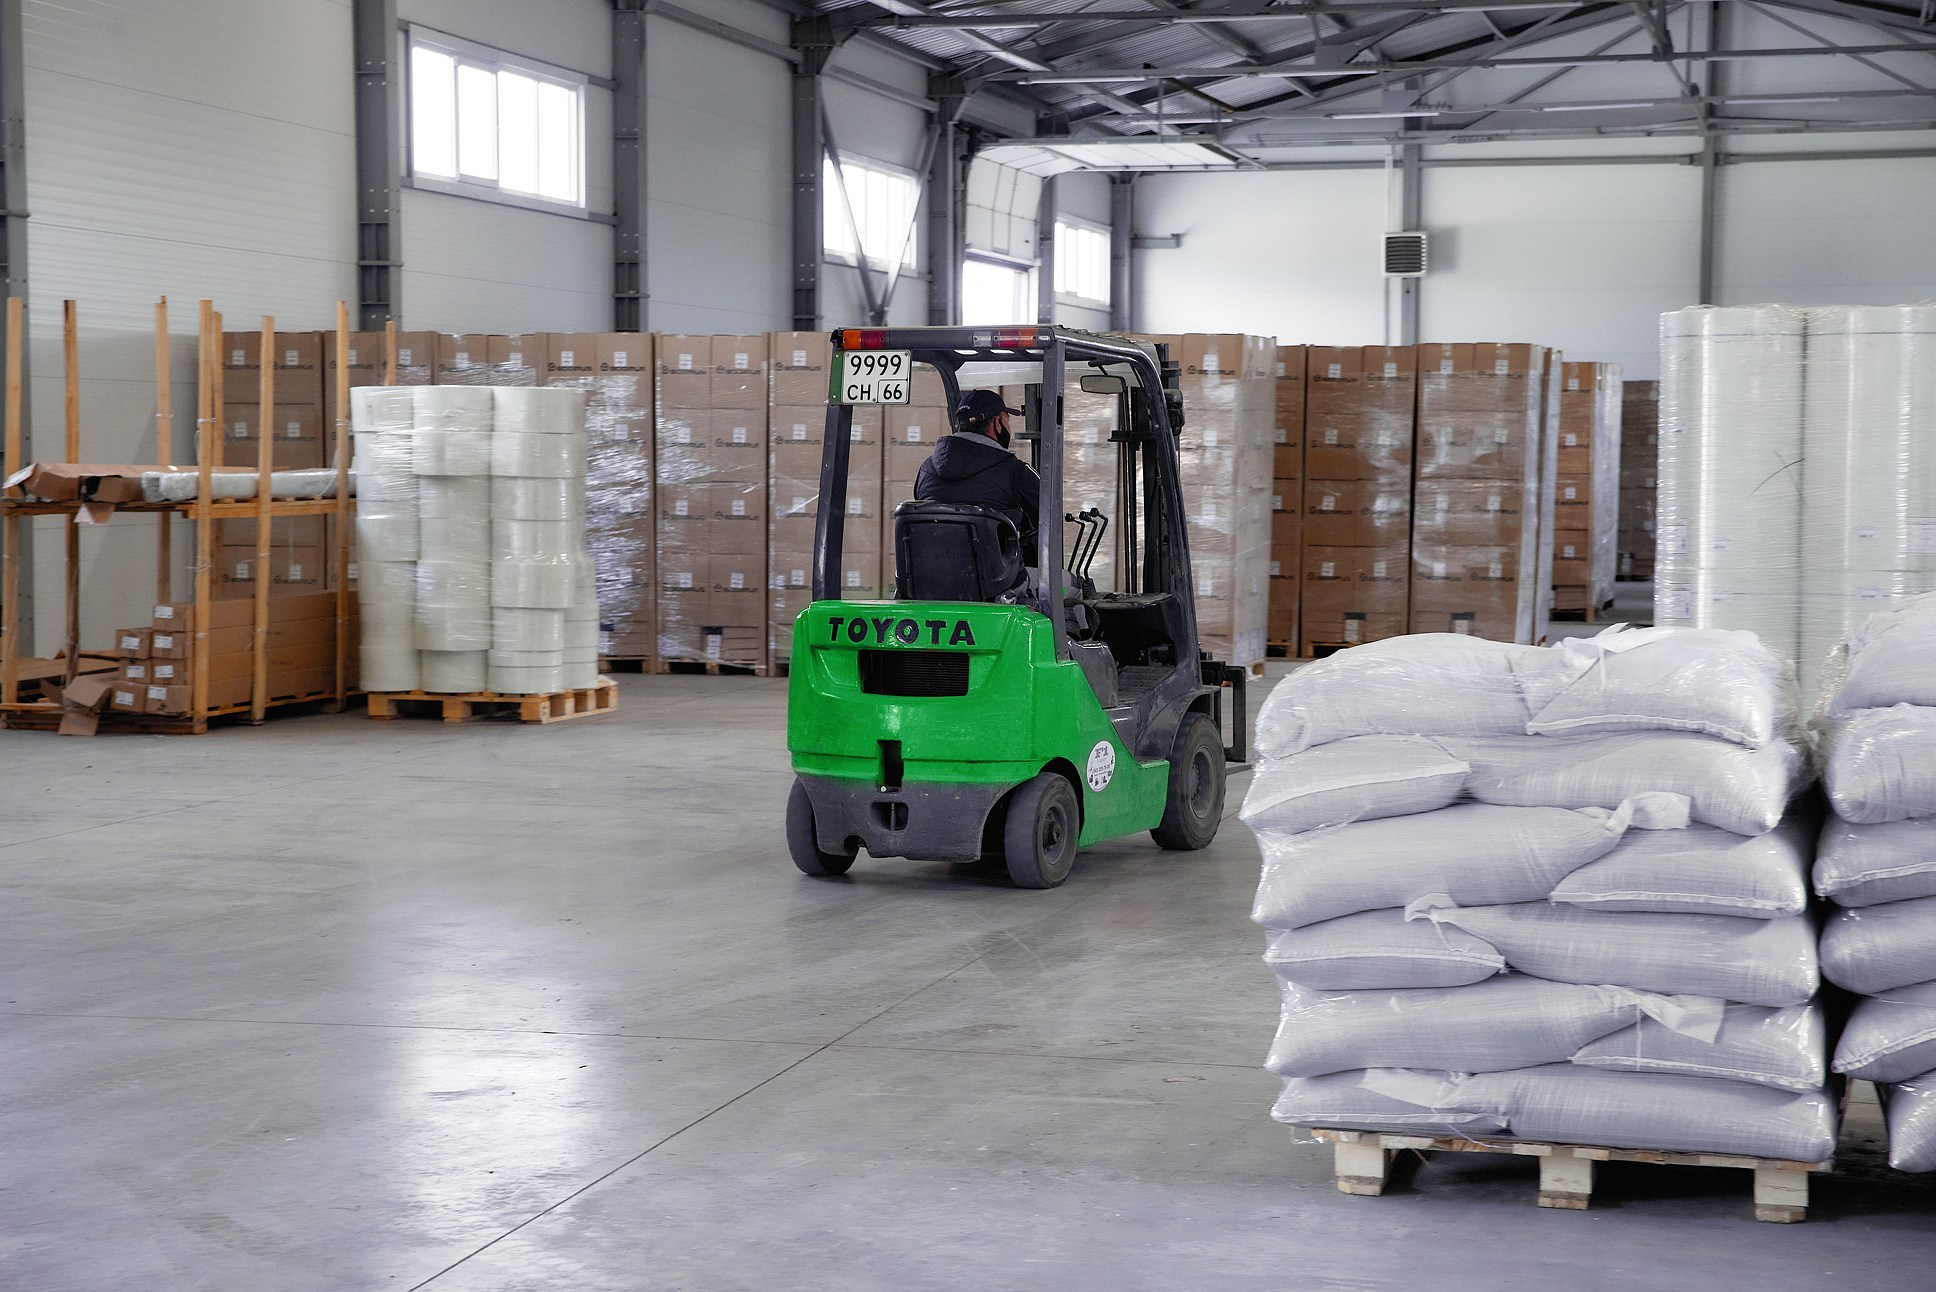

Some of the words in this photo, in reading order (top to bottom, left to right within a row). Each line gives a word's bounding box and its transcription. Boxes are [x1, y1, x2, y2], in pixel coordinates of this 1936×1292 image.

[850, 354, 902, 376] 9999
[847, 384, 871, 401] CH
[883, 384, 903, 400] 66
[828, 616, 976, 646] TOYOTA
